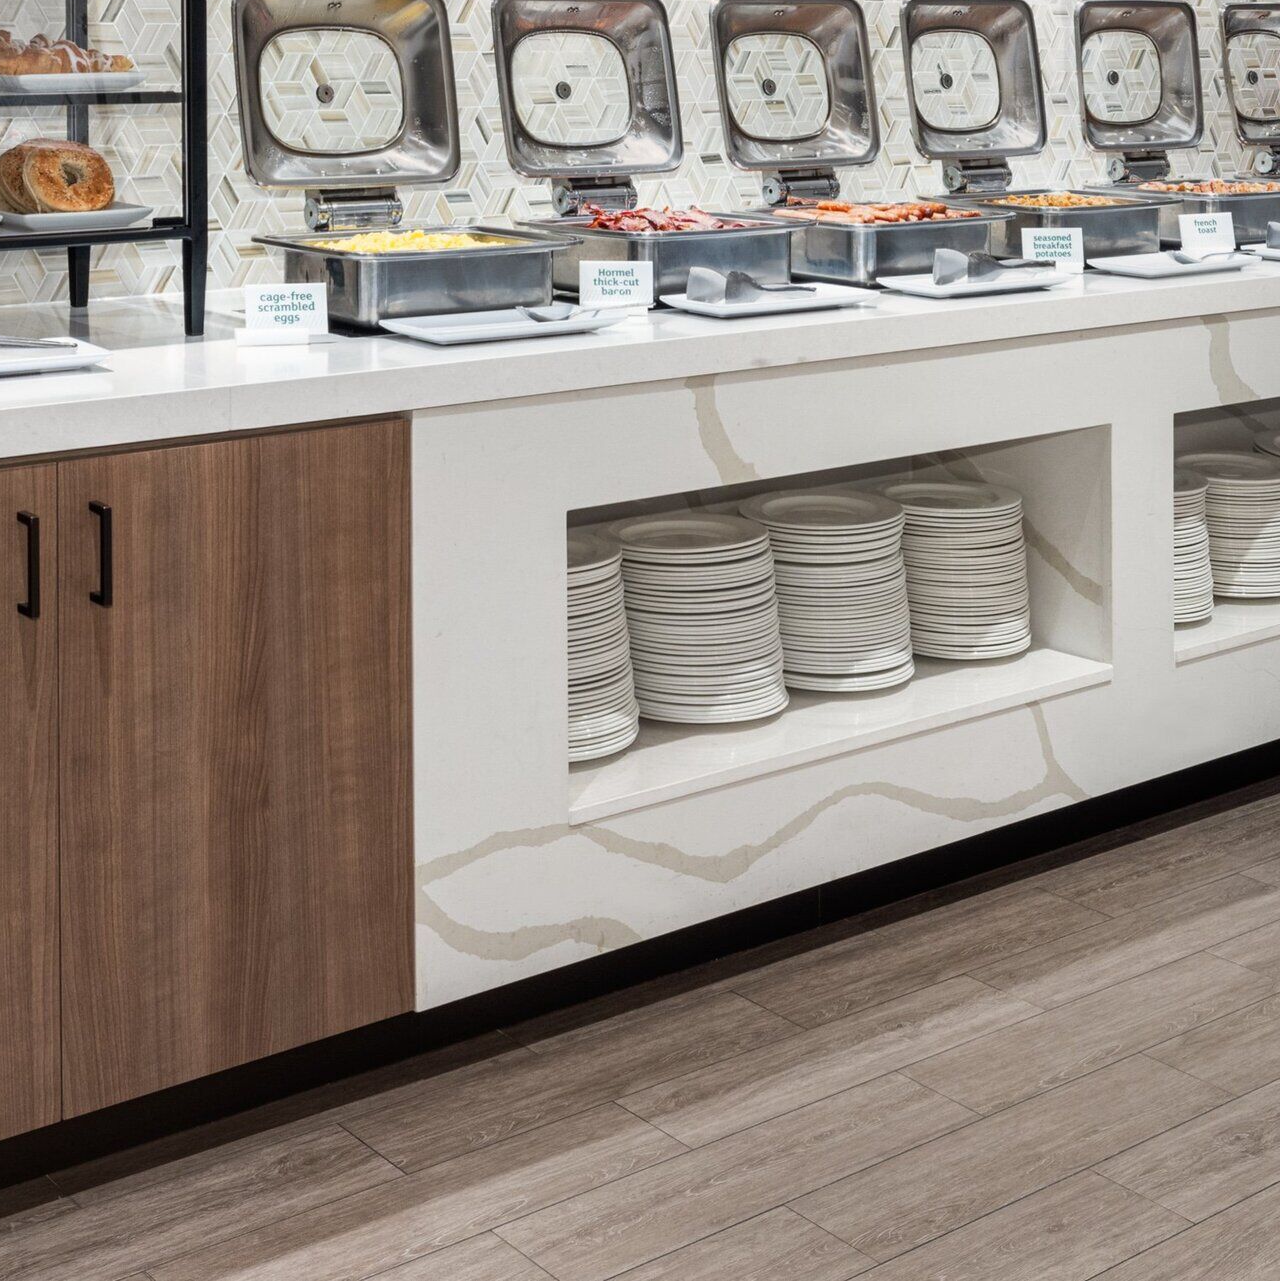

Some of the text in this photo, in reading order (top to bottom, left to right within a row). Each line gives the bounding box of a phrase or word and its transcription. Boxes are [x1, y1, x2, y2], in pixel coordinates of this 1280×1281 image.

[1035, 250, 1071, 258] potatoes
[598, 268, 634, 277] Hormel
[593, 277, 639, 286] thick-cut
[601, 287, 632, 295] bacon
[260, 291, 312, 304] cage-free
[258, 301, 315, 312] scrambled
[274, 314, 300, 324] eggs
